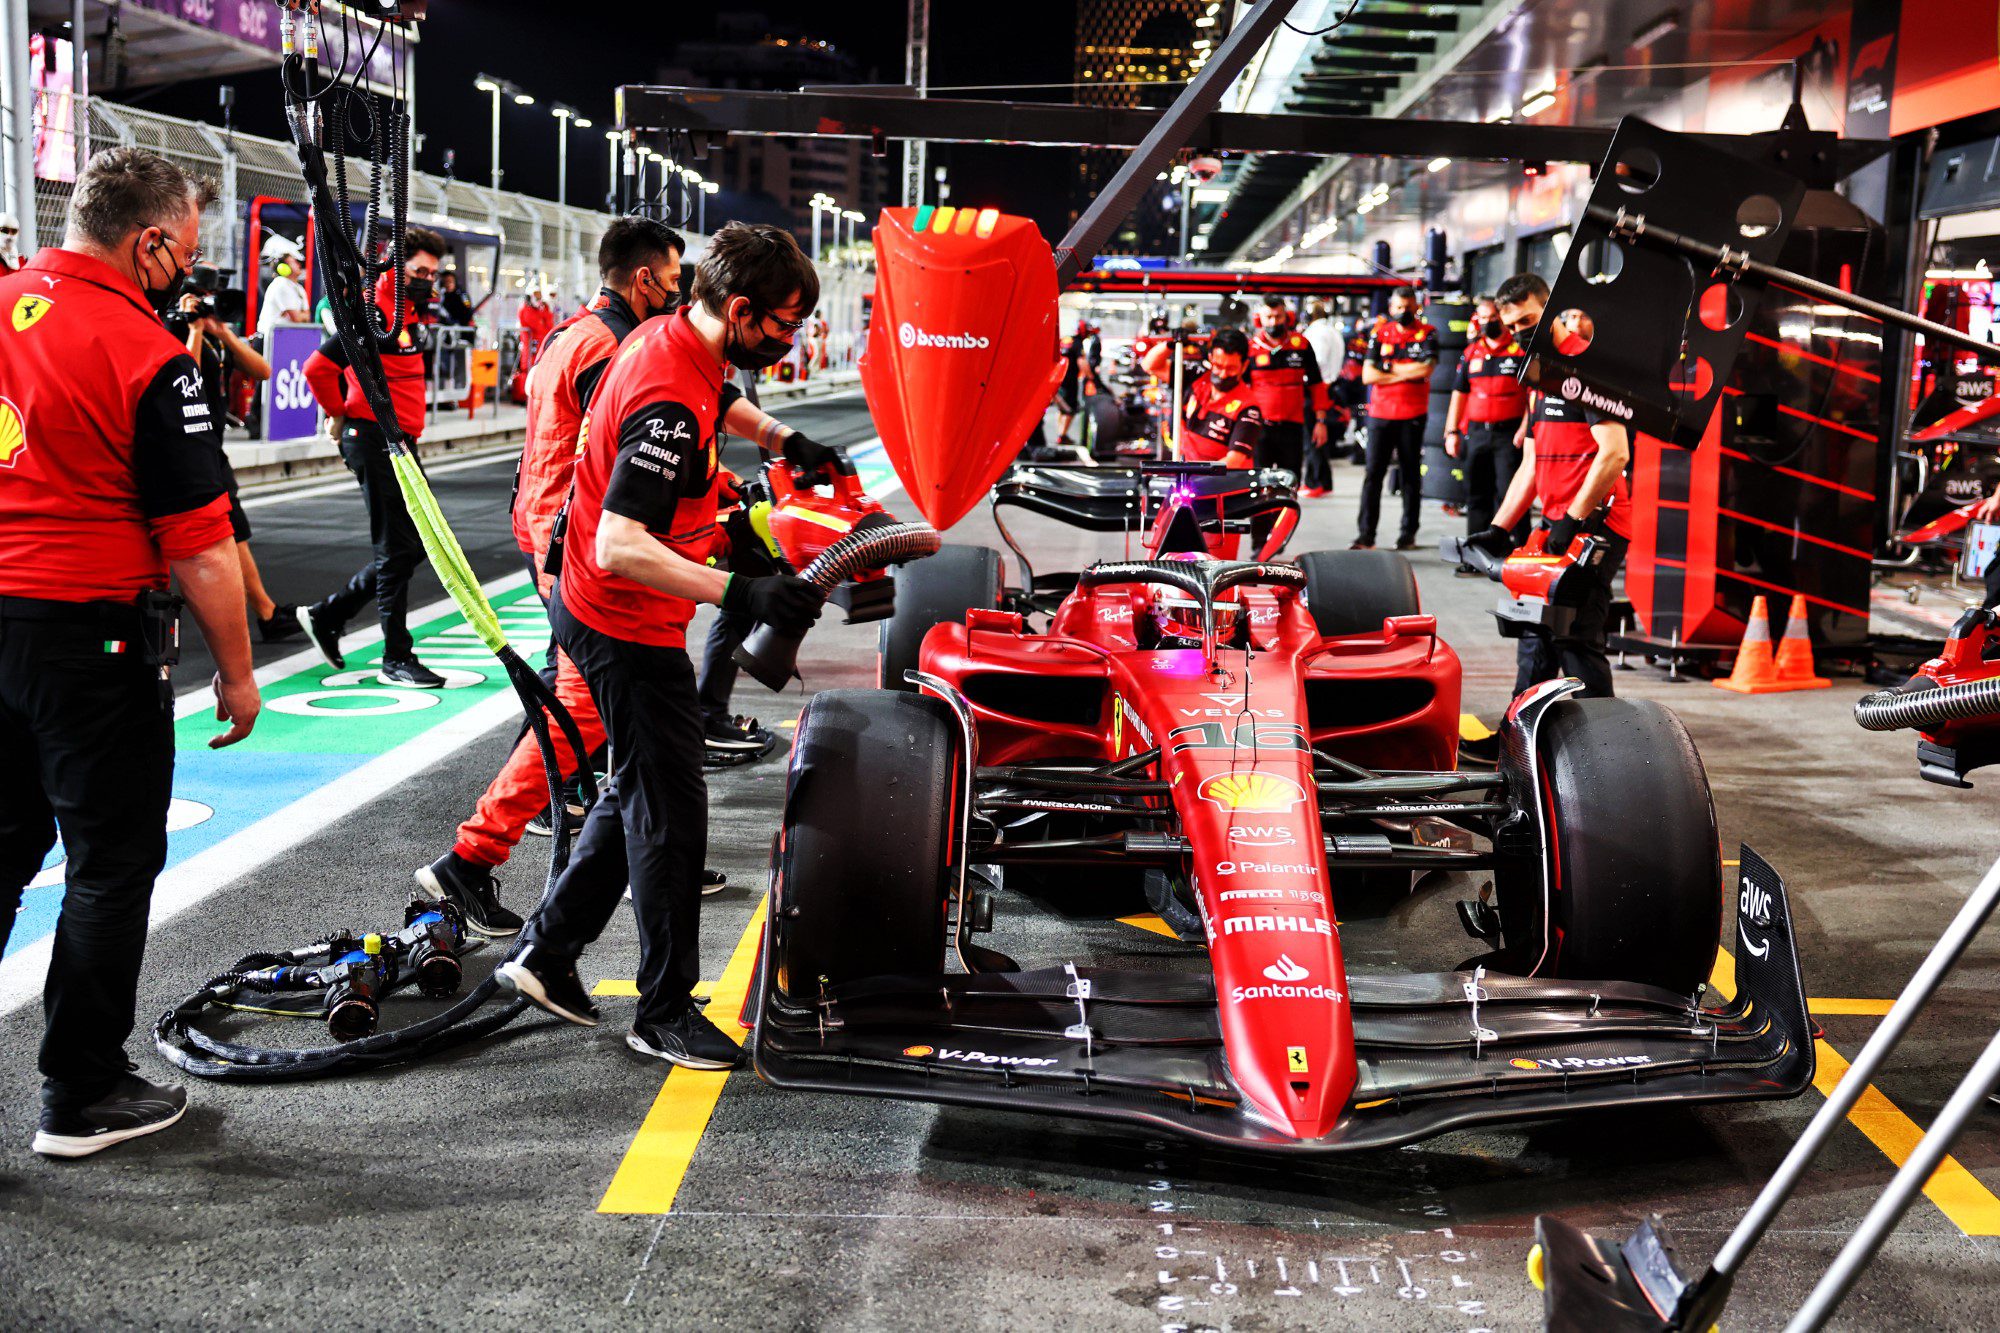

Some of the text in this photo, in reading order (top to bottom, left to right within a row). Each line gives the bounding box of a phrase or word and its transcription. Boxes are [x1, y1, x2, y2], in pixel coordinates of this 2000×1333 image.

[917, 328, 990, 349] brembo
[275, 359, 314, 410] stc
[1955, 381, 1993, 397] aws
[1581, 386, 1634, 420] brembo
[645, 418, 691, 441] Ray-Ban
[639, 441, 681, 465] MAHLE
[630, 456, 661, 473] PIRELLI
[1945, 480, 1982, 495] aws
[1266, 566, 1304, 579] Snapdragon
[1098, 605, 1134, 622] Ray-Ban
[1246, 607, 1281, 623] Ray-Ban
[1179, 708, 1285, 718] VELAS
[1169, 722, 1311, 755] 16
[1022, 799, 1112, 811] #WeRaceAsOne
[1229, 826, 1292, 837] aws
[1240, 861, 1318, 875] Palantir
[1220, 889, 1283, 901] PIRELLI
[1740, 877, 1772, 920] aws
[1223, 916, 1332, 936] MAHLE
[1232, 983, 1344, 1004] Santander
[938, 1049, 1059, 1066] V-Power
[1537, 1055, 1652, 1069] V-Power
